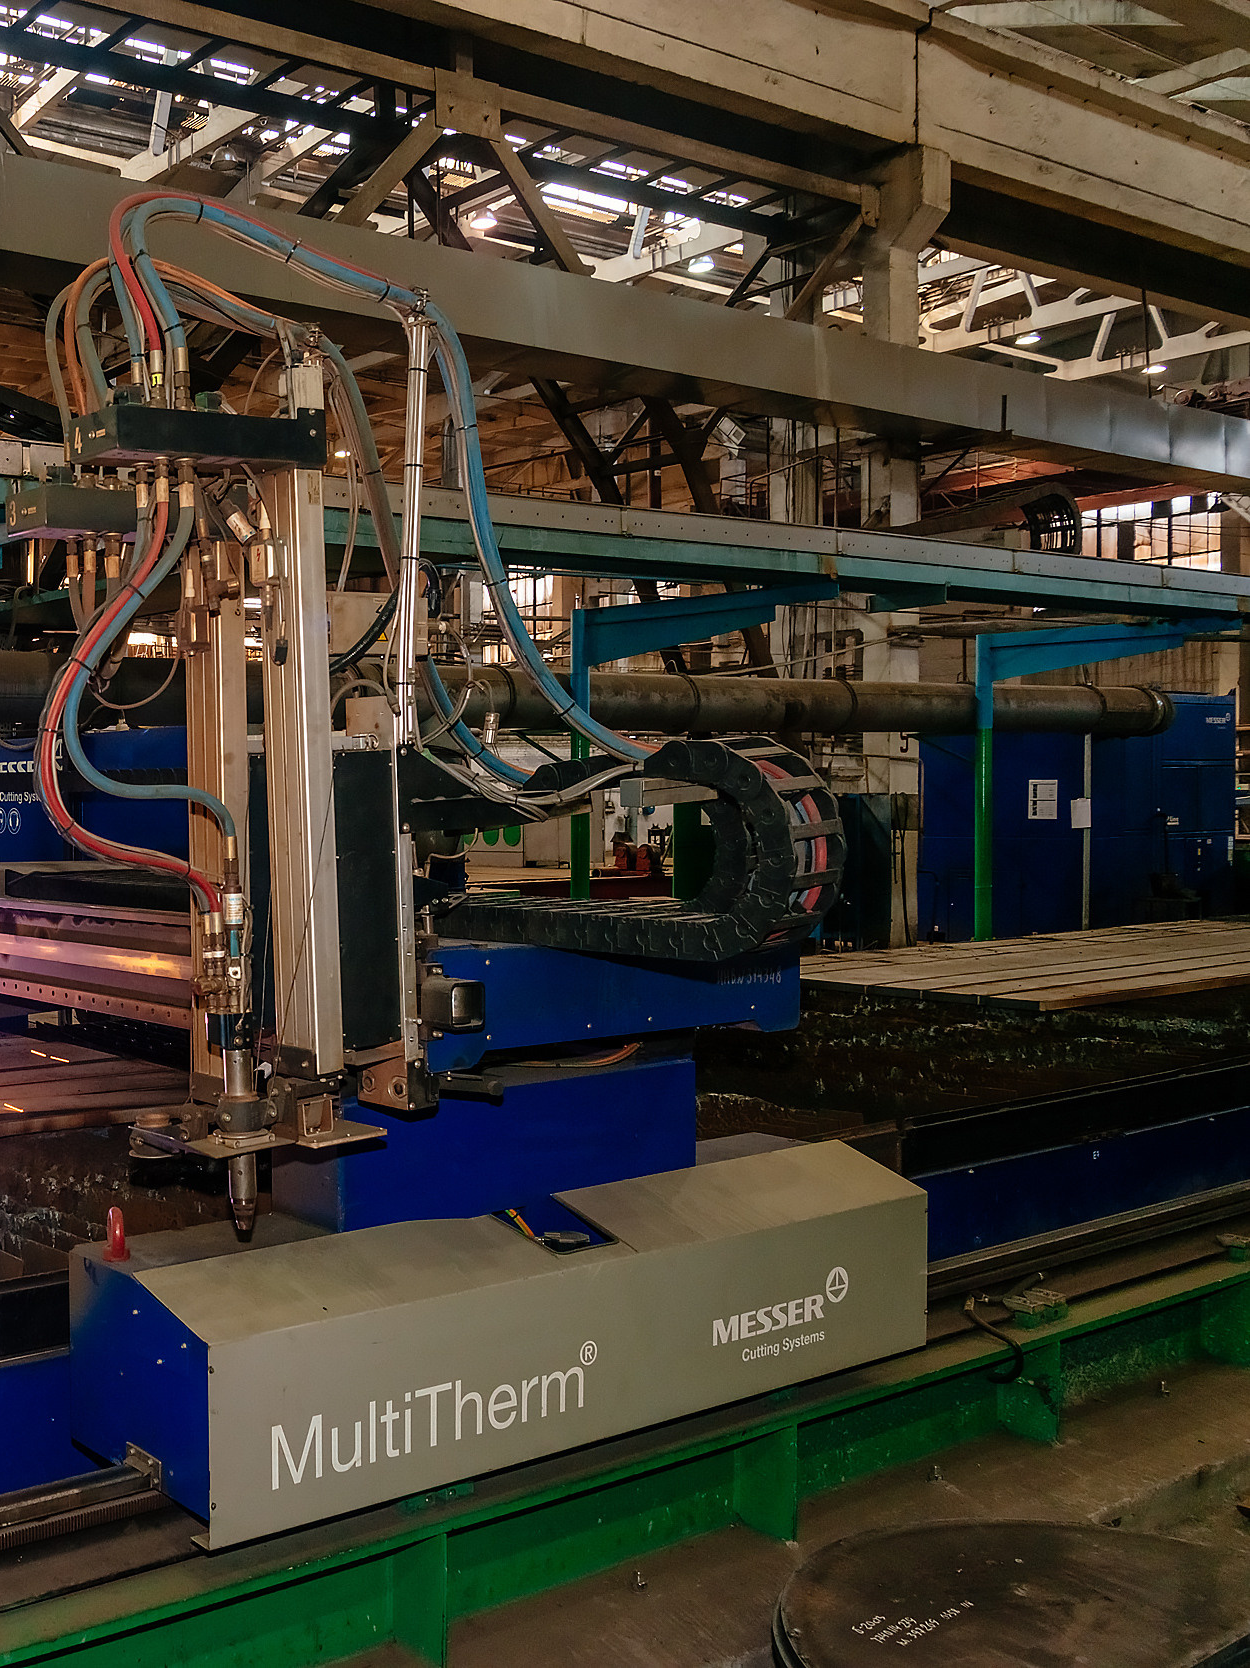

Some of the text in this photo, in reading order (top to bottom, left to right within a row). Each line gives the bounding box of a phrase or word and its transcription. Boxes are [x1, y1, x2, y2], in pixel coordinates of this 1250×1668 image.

[74, 426, 82, 454] 4
[10, 500, 17, 526] 3
[0, 791, 23, 804] Cutting
[712, 1294, 825, 1346] MESSER
[741, 1330, 825, 1362] Cutting Systems
